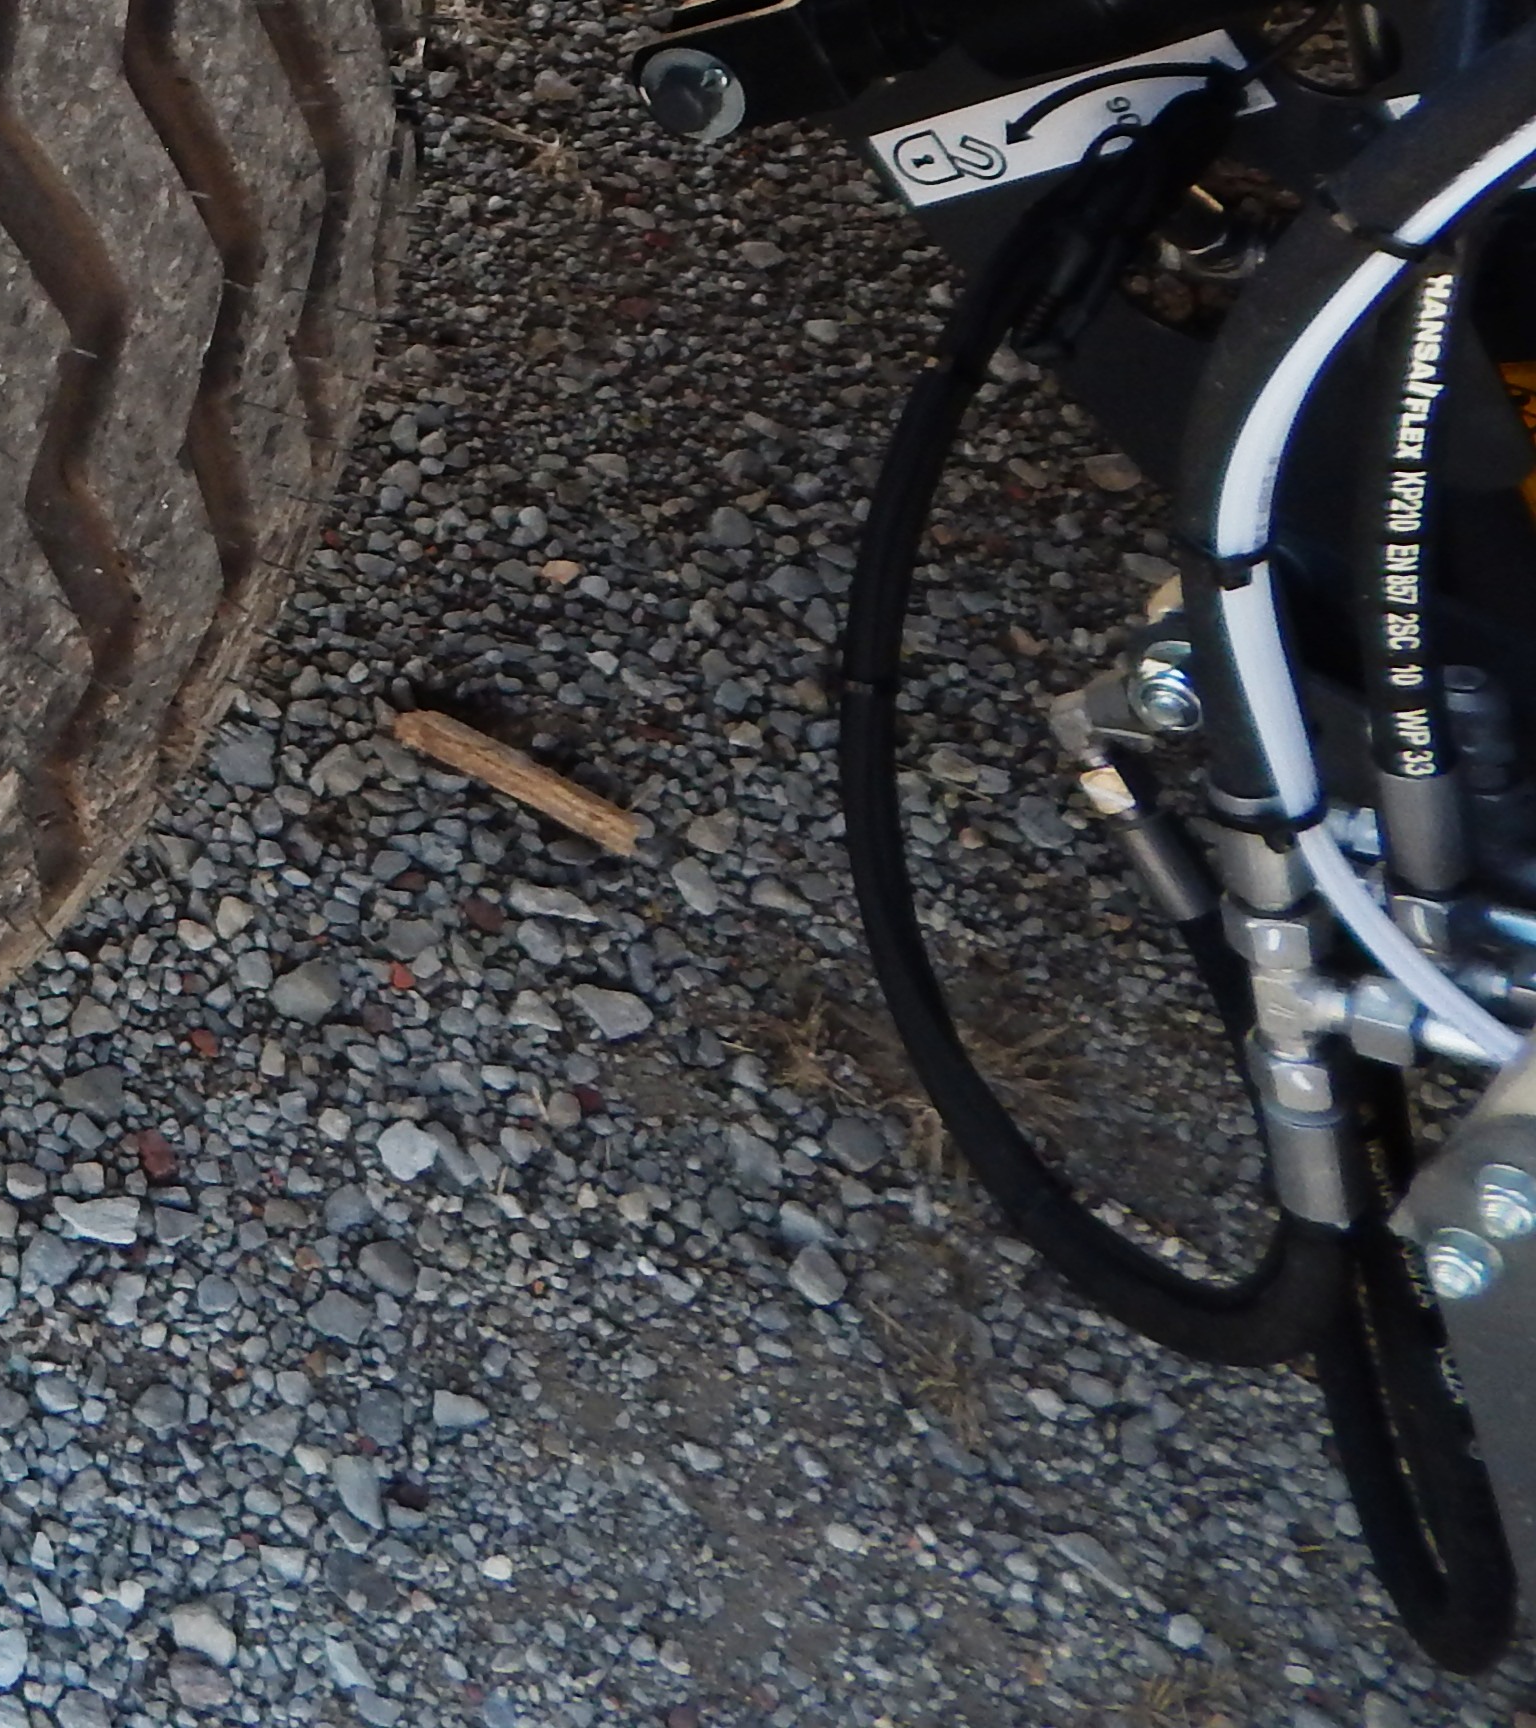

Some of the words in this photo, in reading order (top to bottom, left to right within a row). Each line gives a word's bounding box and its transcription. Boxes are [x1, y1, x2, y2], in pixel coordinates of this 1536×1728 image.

[1385, 544, 1420, 569] EN
[1384, 574, 1418, 605] 857
[1383, 613, 1420, 651] 2SC
[1391, 664, 1424, 686] 10
[1393, 709, 1431, 746] WP
[1401, 749, 1437, 776] 33
